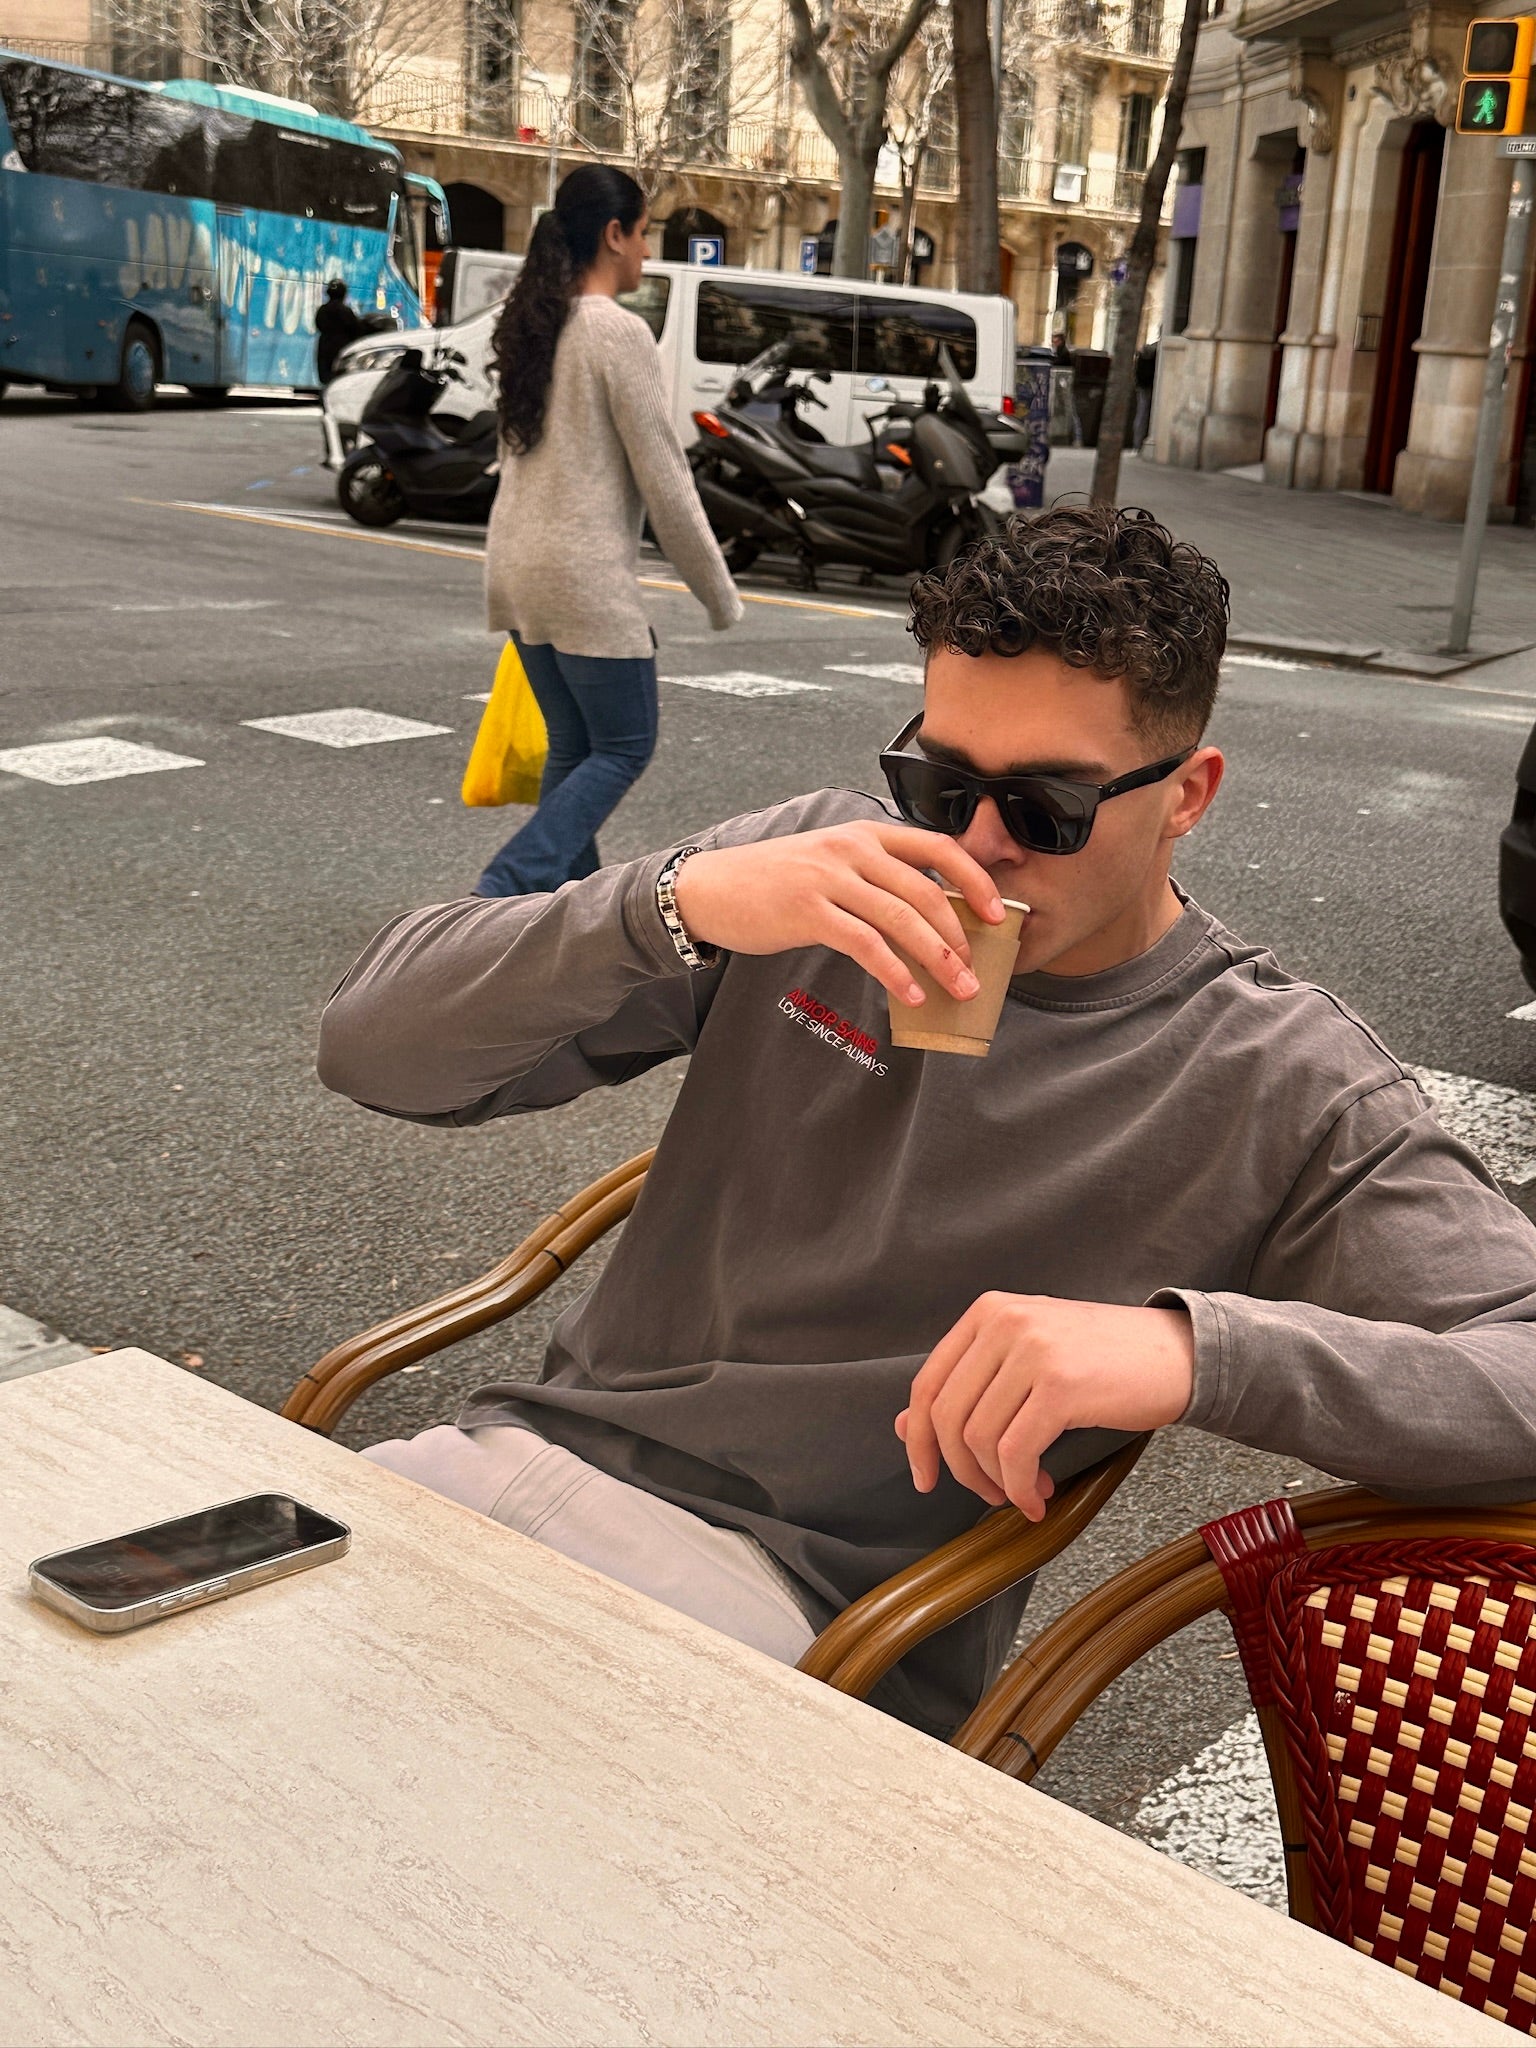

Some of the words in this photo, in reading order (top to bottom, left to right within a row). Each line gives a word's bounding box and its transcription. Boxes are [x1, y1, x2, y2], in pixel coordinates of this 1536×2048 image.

[695, 242, 716, 265] P
[778, 997, 810, 1025] LOVE
[806, 1019, 845, 1049] SINCE
[840, 1044, 889, 1077] ALWAYS
[786, 988, 838, 1026] AMOR
[835, 1020, 880, 1055] SANS
